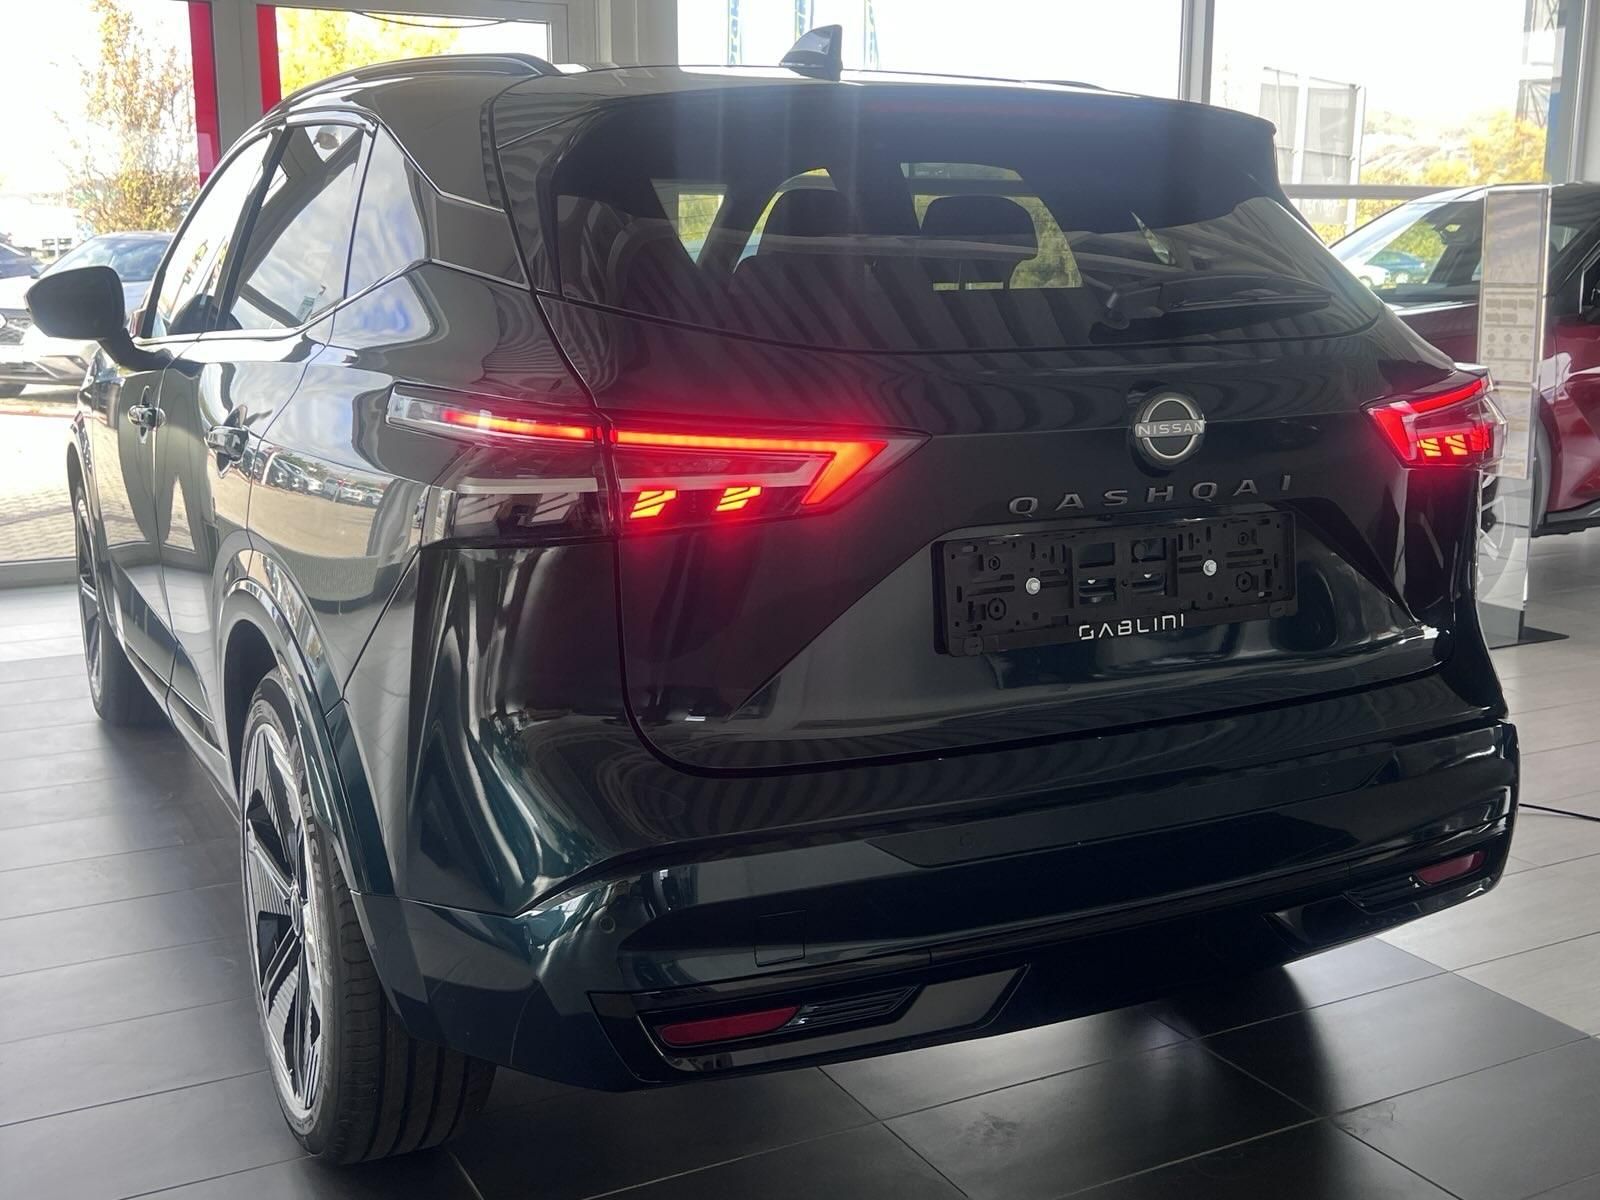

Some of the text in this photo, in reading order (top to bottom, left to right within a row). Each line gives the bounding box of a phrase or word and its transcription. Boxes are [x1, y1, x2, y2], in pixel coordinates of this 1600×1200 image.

[1138, 421, 1204, 435] NISSAN
[1008, 475, 1291, 517] QASHQAI
[1078, 613, 1184, 640] GABLINI
